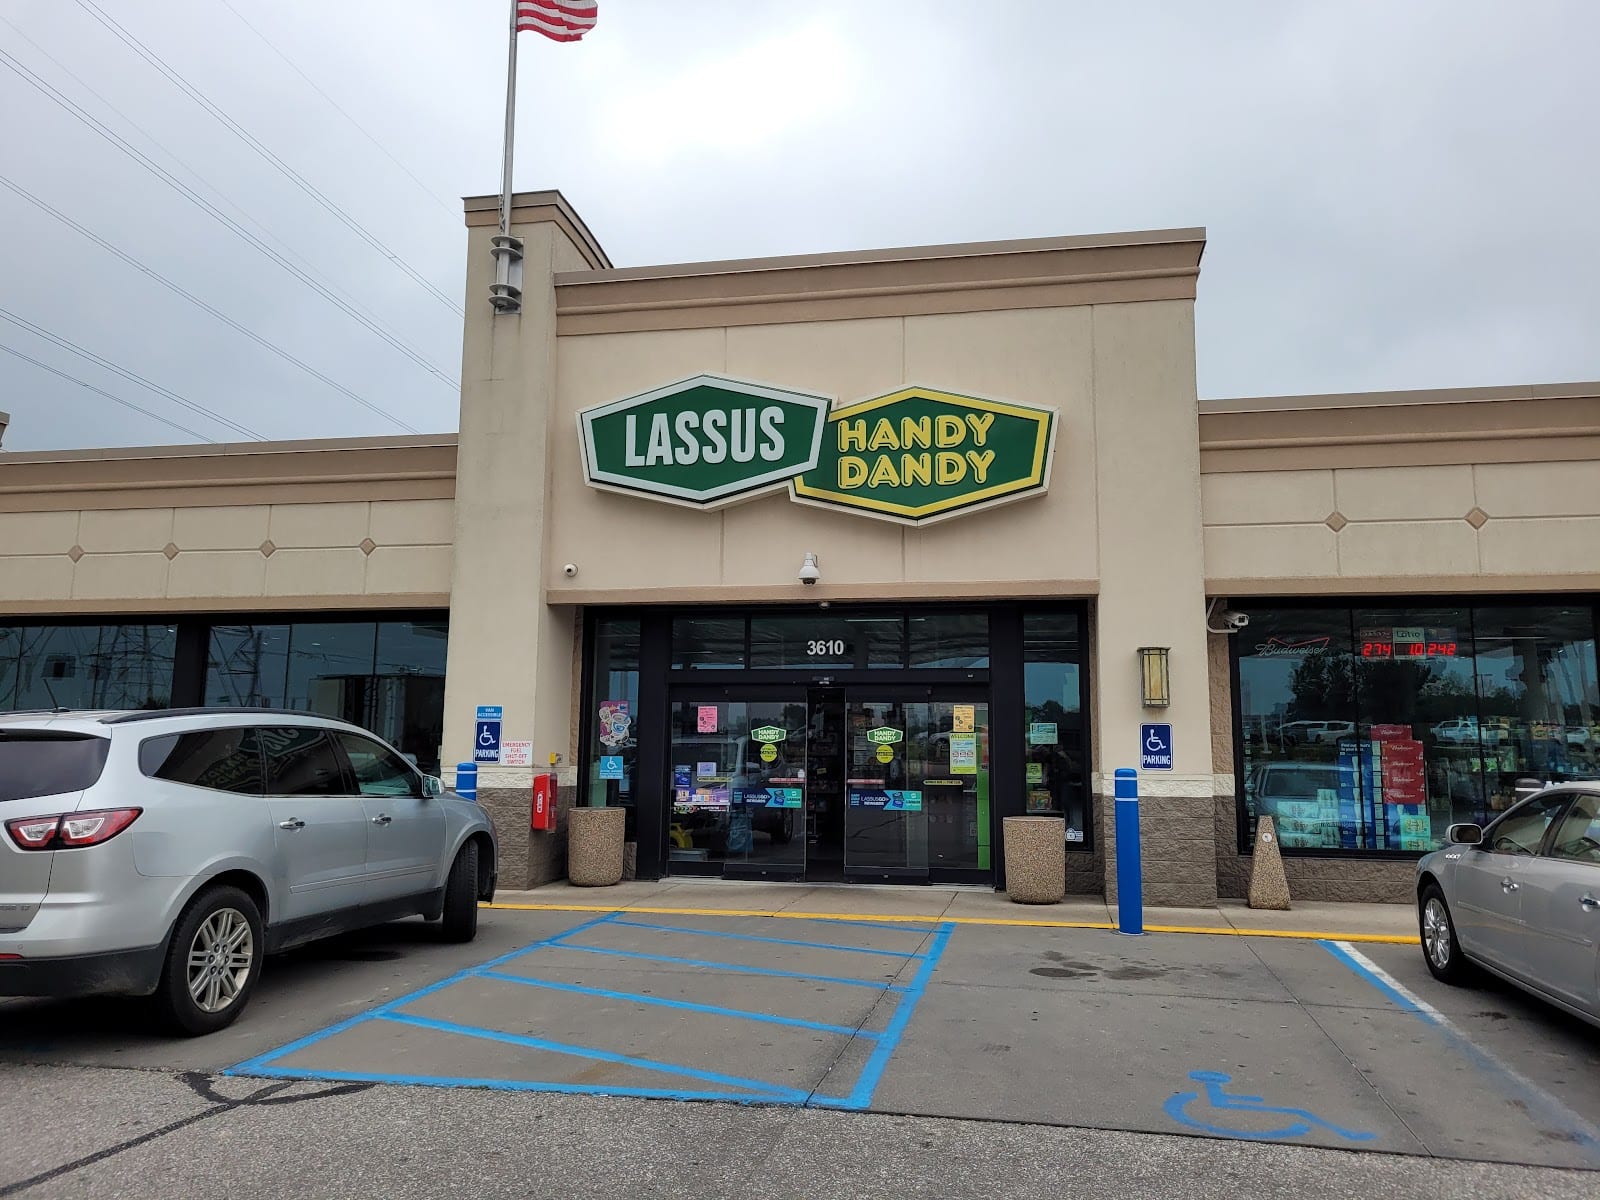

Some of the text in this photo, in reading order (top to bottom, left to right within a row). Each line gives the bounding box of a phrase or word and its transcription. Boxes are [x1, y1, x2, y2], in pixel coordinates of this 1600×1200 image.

[624, 405, 786, 469] LASSUS
[837, 412, 996, 453] HANDY
[837, 449, 997, 490] DANDY
[806, 639, 845, 655] 3610
[1255, 643, 1328, 657] Budweiser
[1362, 643, 1392, 656] 274
[1427, 643, 1457, 656] 242
[475, 748, 499, 758] PARKING
[1143, 754, 1171, 765] PARKING
